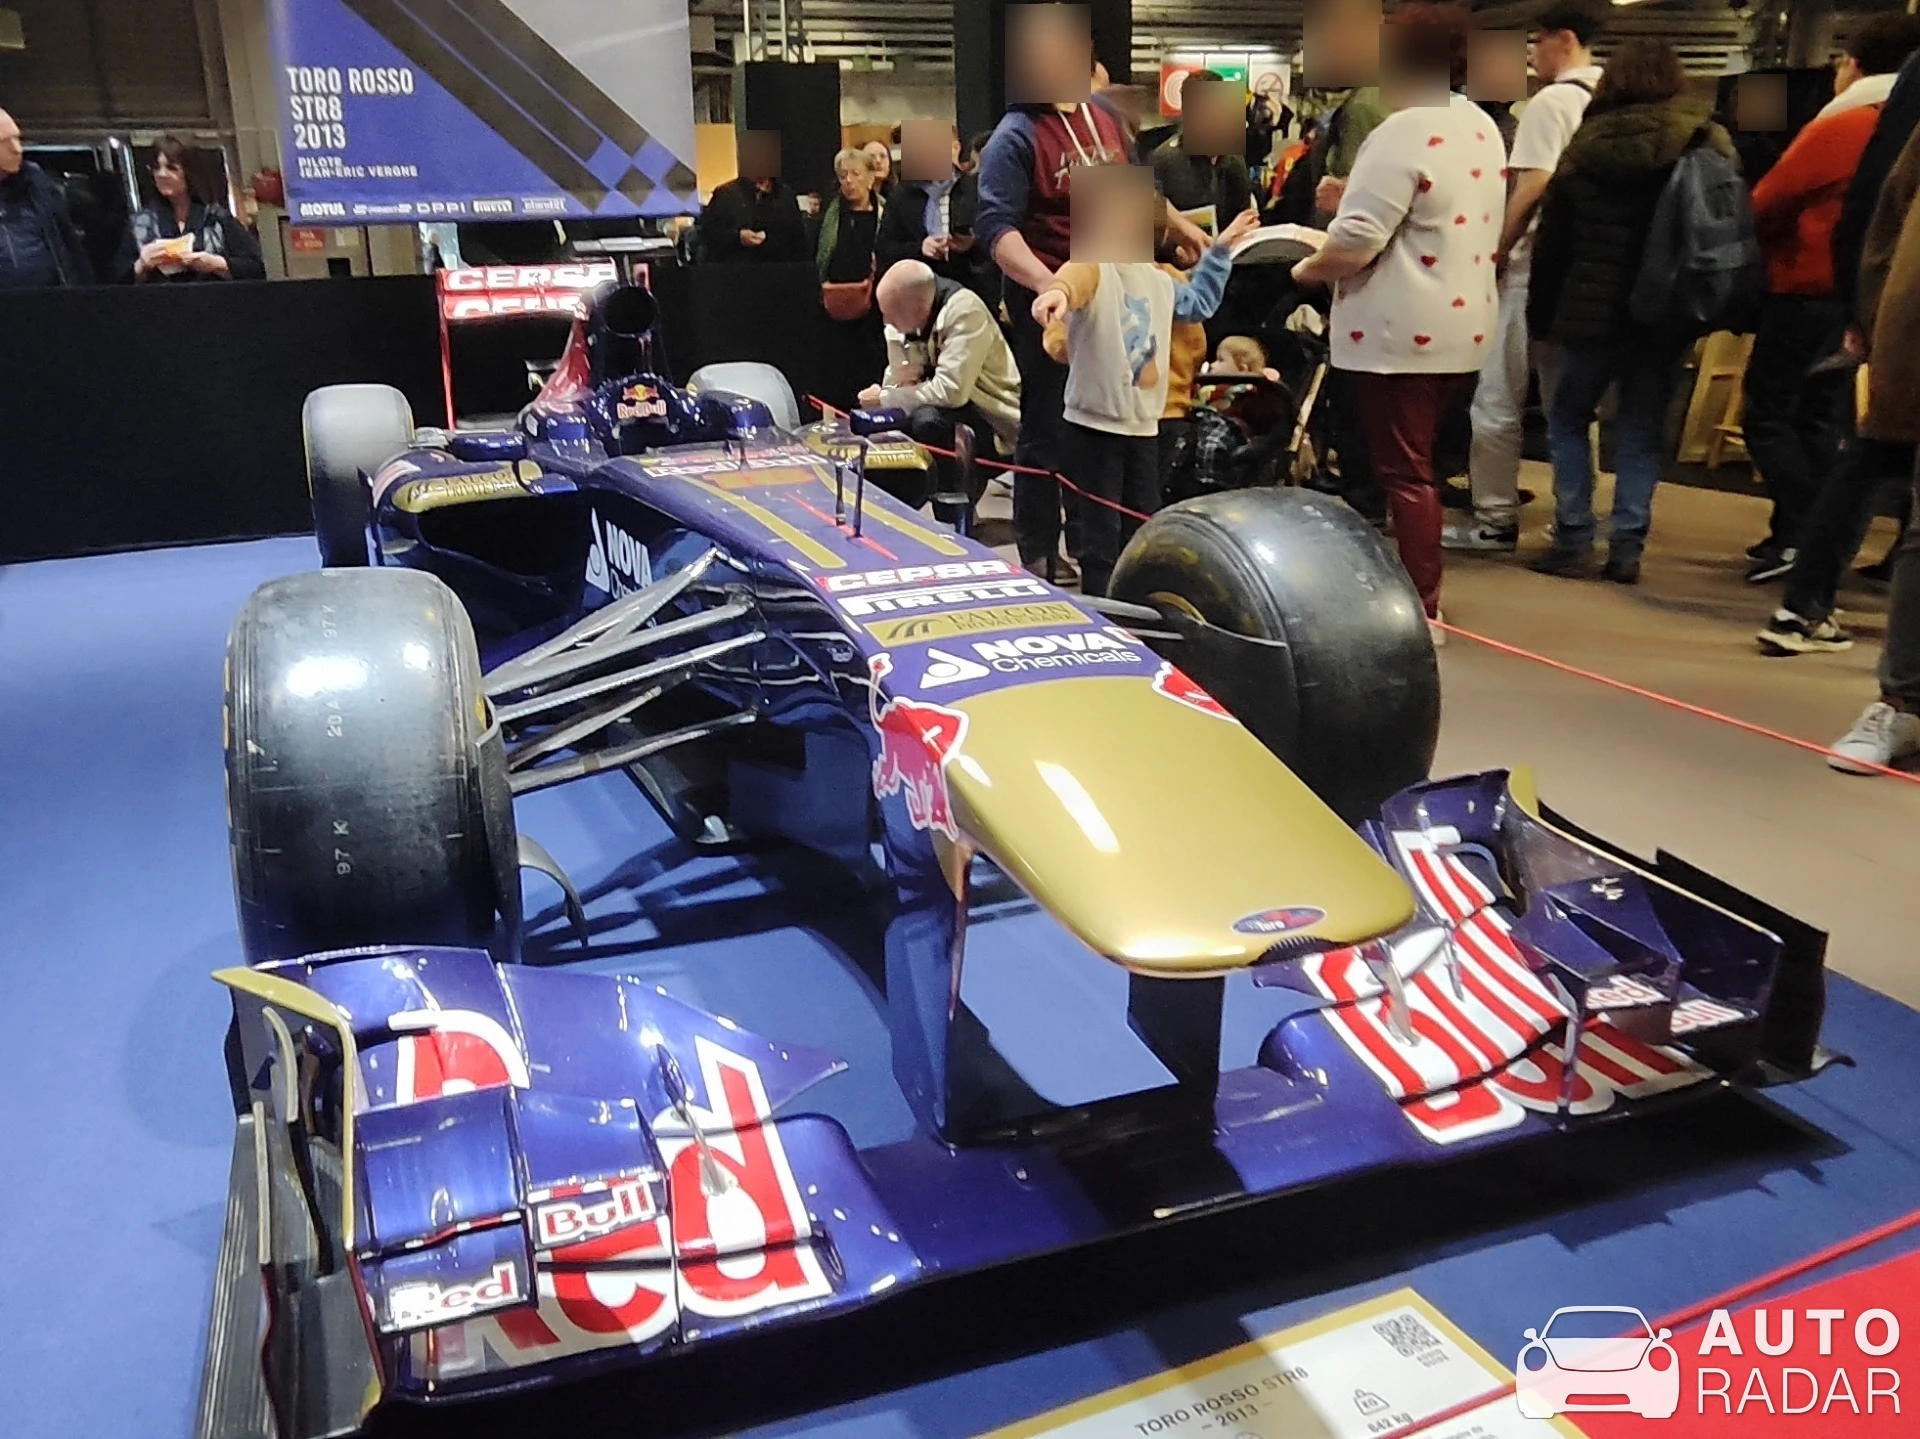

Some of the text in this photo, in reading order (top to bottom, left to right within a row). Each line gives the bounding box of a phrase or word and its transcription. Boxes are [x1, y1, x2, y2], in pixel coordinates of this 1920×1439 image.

[286, 66, 414, 95] TORO ROSSO
[290, 95, 343, 121] STR8
[293, 123, 346, 150] 2013
[298, 157, 343, 168] PILOTE
[300, 202, 346, 216] MOTUL
[417, 202, 465, 214] DPPI
[606, 520, 653, 588] NOVA
[827, 561, 1012, 590] CEPSA
[837, 578, 1050, 616] PIRELLI
[947, 603, 1073, 623] FALCON
[972, 632, 1122, 662] NOVA
[992, 650, 1141, 673] Chemicals
[333, 820, 351, 876] 97 K
[541, 1184, 656, 1244] Bull
[1134, 1408, 1192, 1437] TORO
[1191, 1383, 1261, 1418] ROSSO
[1213, 1400, 1260, 1428] 2013
